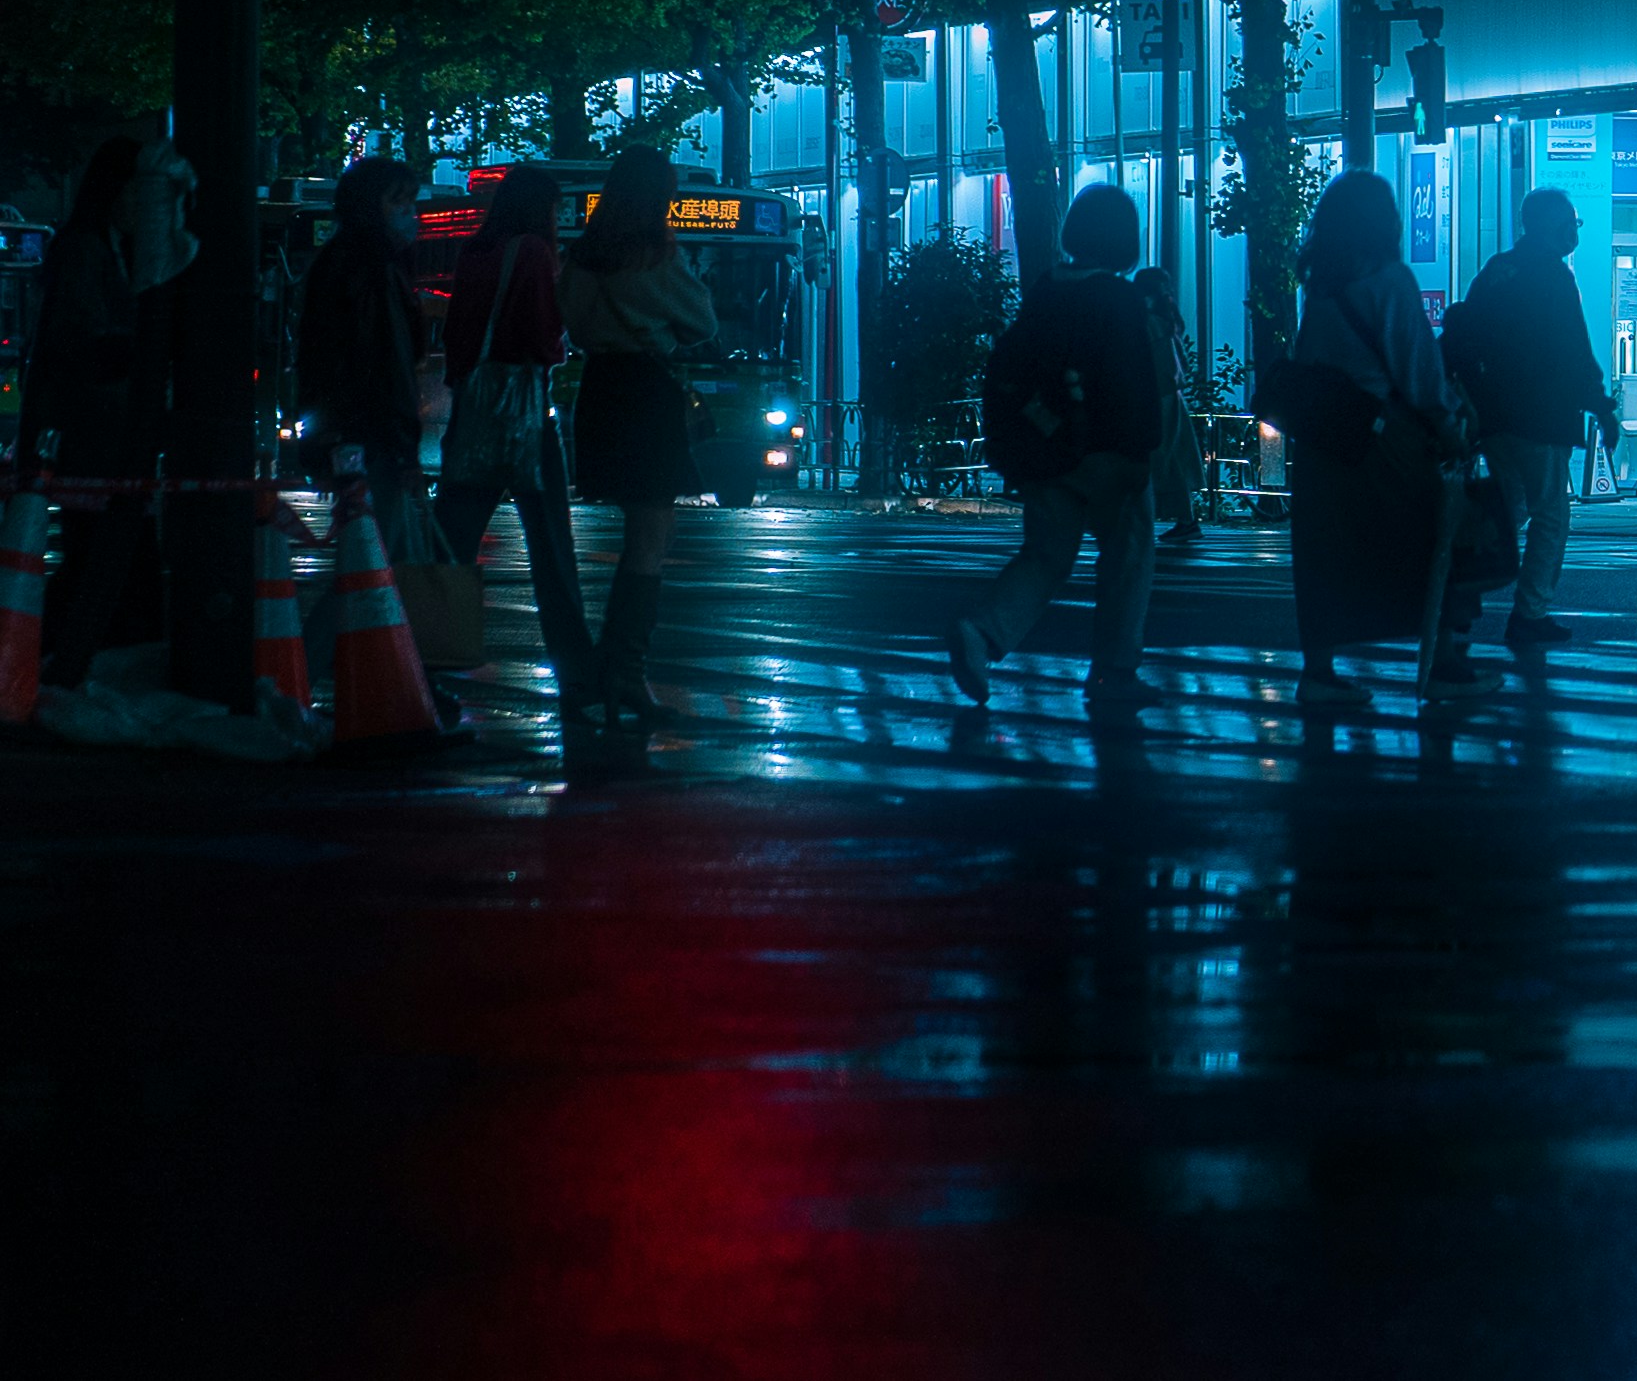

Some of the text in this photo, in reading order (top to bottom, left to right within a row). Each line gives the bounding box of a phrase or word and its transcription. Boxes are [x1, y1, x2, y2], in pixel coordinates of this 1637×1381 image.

[1129, 2, 1190, 21] TAI
[1550, 119, 1593, 130] PHILIPS
[1550, 139, 1593, 149] sonicare
